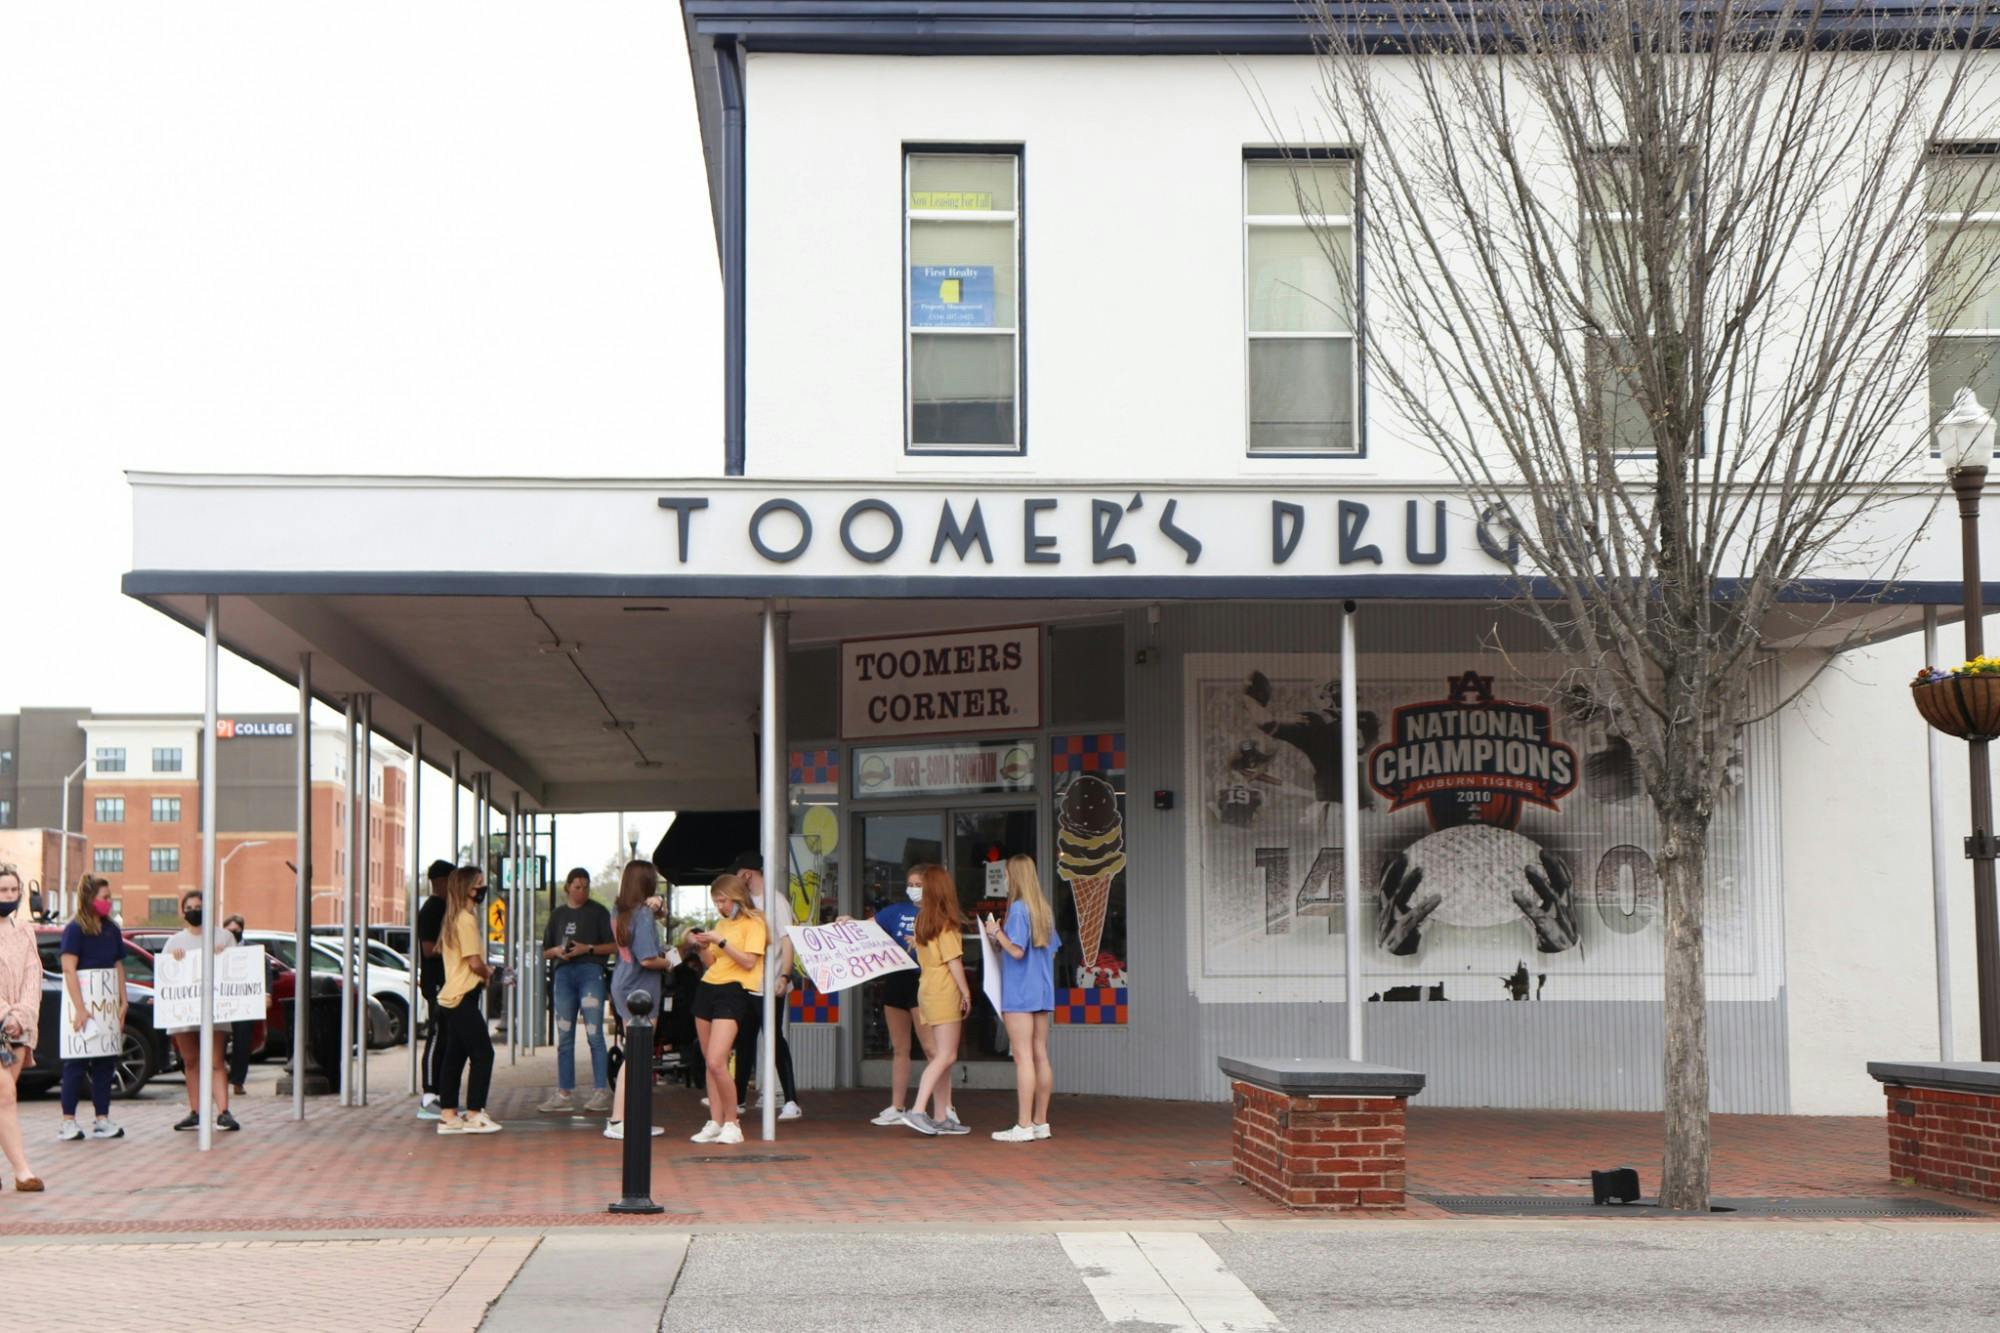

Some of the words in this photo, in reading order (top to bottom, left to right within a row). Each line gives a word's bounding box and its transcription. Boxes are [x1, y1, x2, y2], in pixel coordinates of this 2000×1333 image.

[924, 267, 946, 278] First
[948, 266, 978, 280] Realty
[658, 491, 1202, 565] TOOMER'S
[856, 641, 1022, 681] TOOMERS
[868, 688, 1010, 724] CORNER
[235, 723, 293, 735] COLLEGE
[1406, 709, 1541, 742] NATIONAL
[1376, 739, 1571, 785] CHAMPIONS
[1416, 776, 1475, 791] AUBURN
[1482, 776, 1533, 791] TIGERS
[1457, 791, 1491, 802] 2010
[803, 921, 869, 952] ONE
